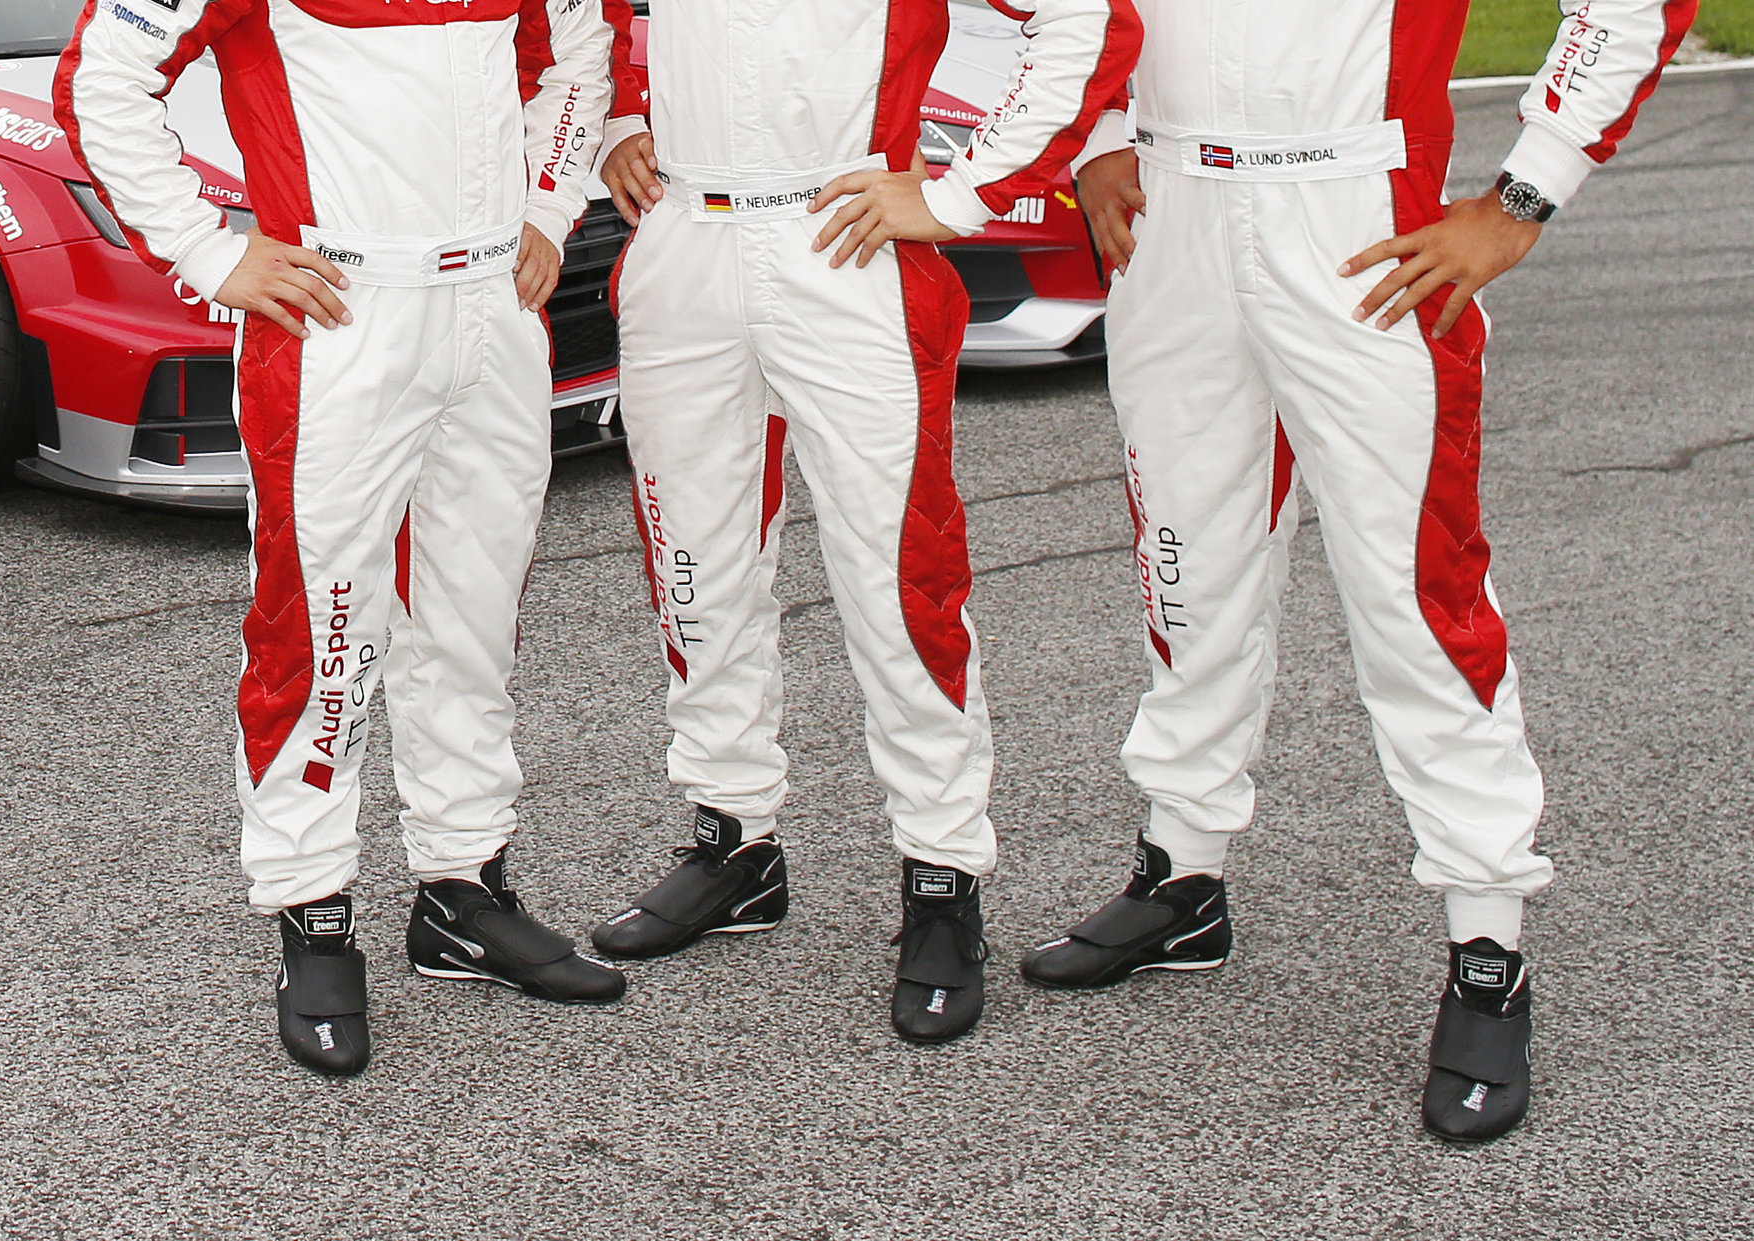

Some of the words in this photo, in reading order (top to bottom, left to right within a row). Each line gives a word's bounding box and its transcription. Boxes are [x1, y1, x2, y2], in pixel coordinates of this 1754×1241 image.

[112, 3, 168, 41] sportscars
[1552, 41, 1580, 88] Audi
[1566, 66, 1587, 93] TT
[1580, 29, 1609, 67] Cup
[560, 154, 577, 177] TT
[1235, 154, 1246, 166] A.
[1249, 151, 1283, 166] LUND
[1285, 148, 1338, 164] SVINDAL
[735, 198, 744, 210] F.
[317, 244, 364, 266] freem
[471, 251, 482, 264] M.
[484, 236, 518, 259] HIRSCHER
[1157, 527, 1183, 586] Cup
[671, 549, 698, 606] Cup
[321, 580, 351, 679] Sport
[675, 614, 703, 648] TT
[1160, 594, 1188, 631] TT
[351, 643, 377, 708] Cup
[313, 689, 344, 757] Audi
[344, 716, 366, 757] TT
